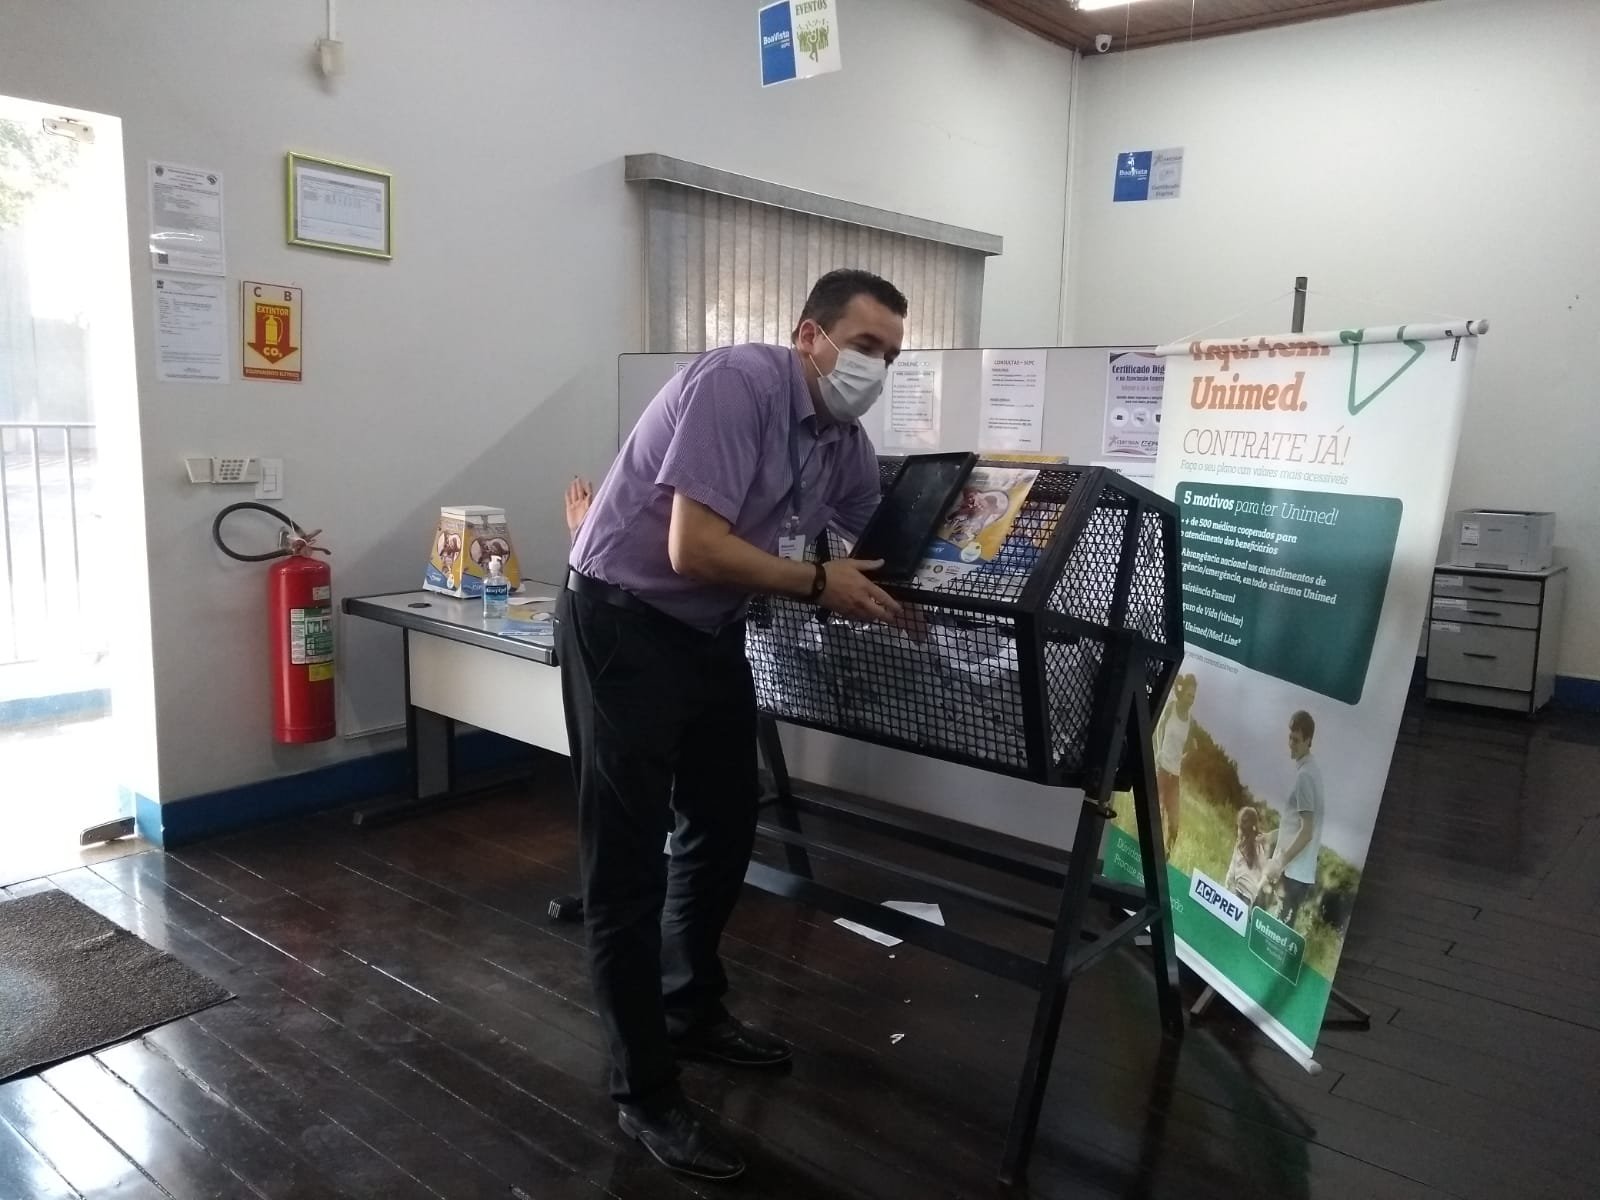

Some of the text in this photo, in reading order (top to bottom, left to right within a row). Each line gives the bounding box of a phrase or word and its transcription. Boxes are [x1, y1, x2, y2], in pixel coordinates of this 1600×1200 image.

[795, 0, 828, 16] EVENTOS
[253, 286, 292, 302] C B
[256, 305, 289, 317] EXTINTOR
[1112, 364, 1165, 376] Certificado Dig
[1190, 371, 1308, 412] Unimed.
[1183, 425, 1351, 466] CONTRATE JÁ!
[1216, 461, 1237, 476] plano
[1279, 469, 1302, 481] mais
[1183, 490, 1340, 526] 5 motivos para ter Unimed!
[1184, 529, 1224, 544] atendimento
[1223, 535, 1235, 546] dos
[1234, 537, 1279, 554] beneficiários
[1190, 516, 1199, 526] de
[1199, 518, 1212, 528] 500
[1211, 520, 1237, 533] médicos
[1237, 527, 1276, 540] cooperados
[1275, 532, 1298, 543] para
[1181, 547, 1221, 563] Abrangência
[1220, 556, 1249, 570] nacional
[1258, 565, 1315, 585] atendimentos
[1315, 575, 1327, 587] de
[1181, 561, 1242, 584] gência/emergência,
[1251, 577, 1268, 589] todo
[1268, 581, 1303, 597] sistema
[1303, 588, 1338, 605] Unimed
[1182, 582, 1236, 604] ssistência Funeral
[1182, 602, 1244, 629] guro de Vida (titular)
[1195, 878, 1244, 922] ACIPREV
[1255, 918, 1288, 946] Unimed
